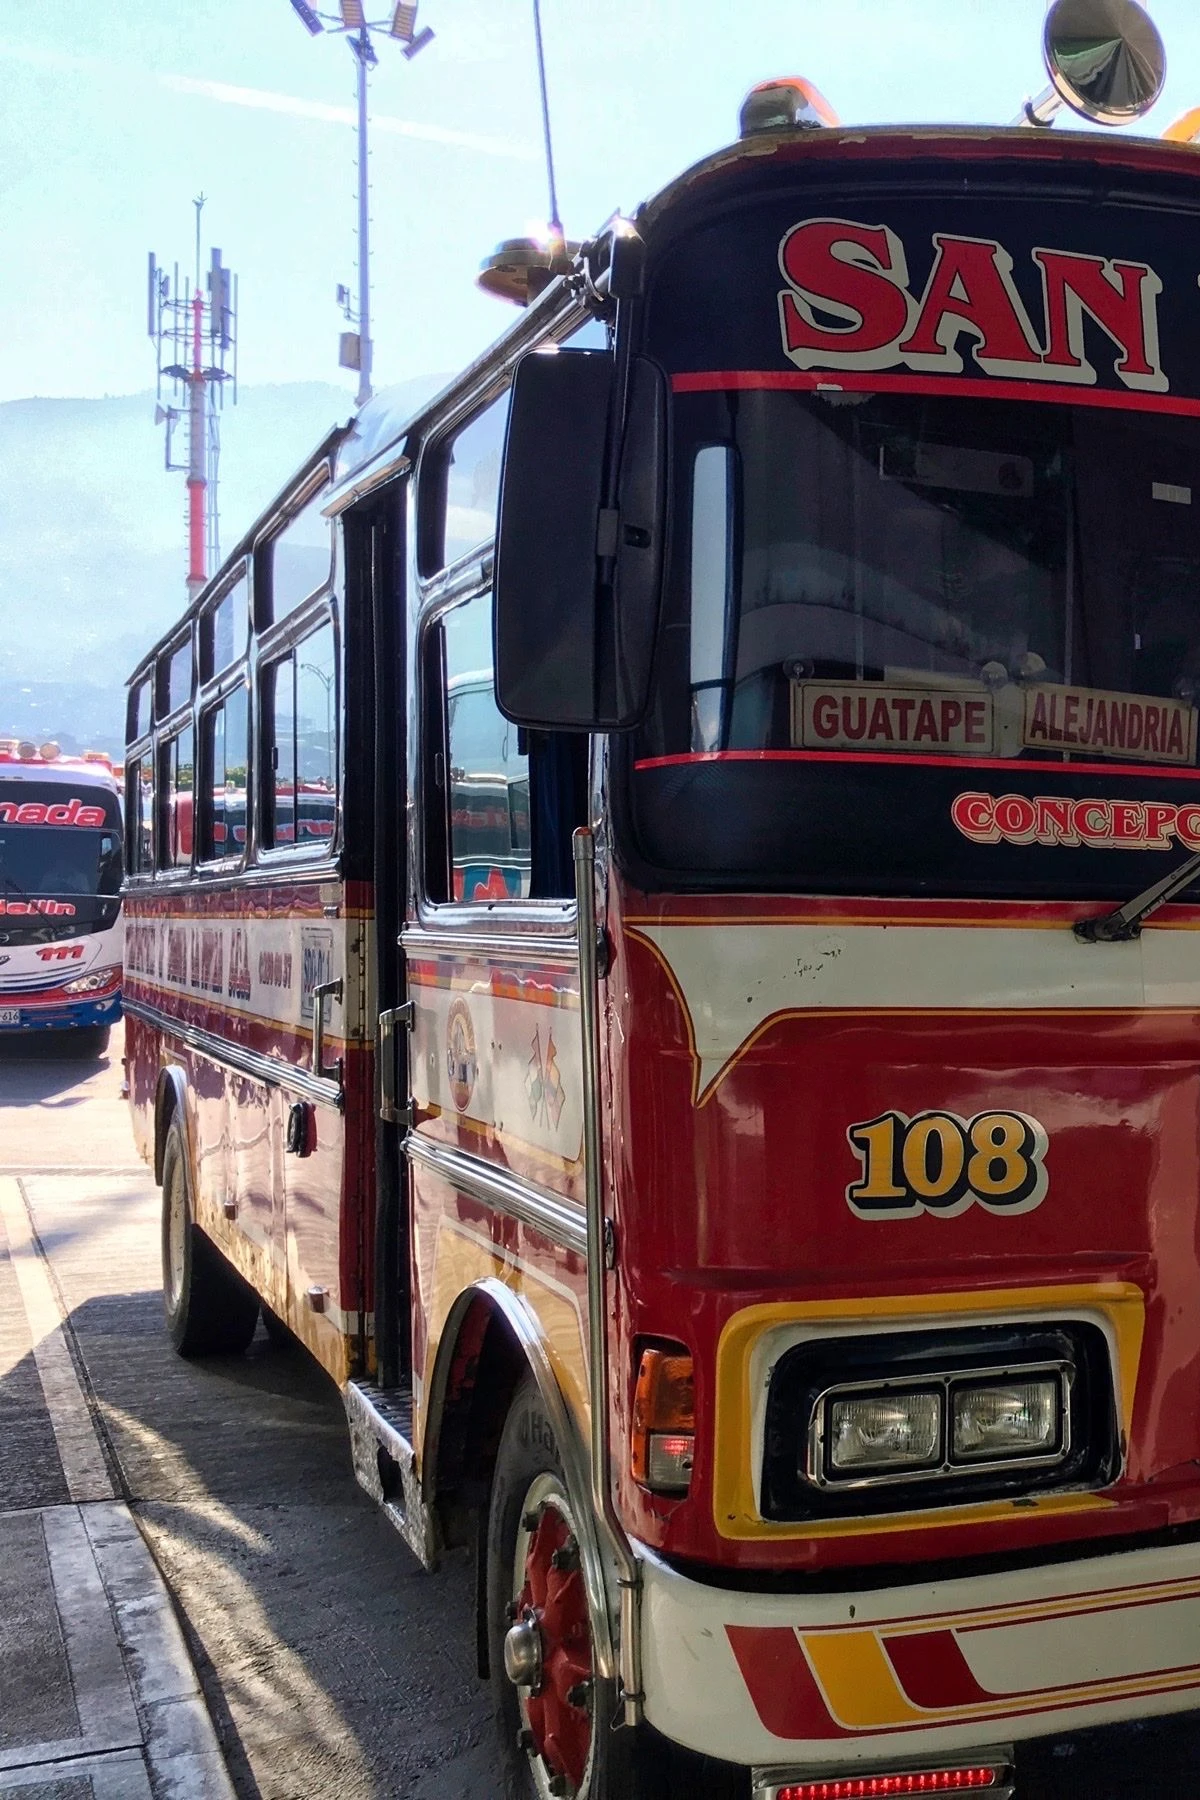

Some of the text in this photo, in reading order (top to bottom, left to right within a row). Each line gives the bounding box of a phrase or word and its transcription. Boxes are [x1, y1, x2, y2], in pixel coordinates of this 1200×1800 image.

[778, 218, 1169, 392] SAN
[812, 695, 987, 743] GUATAPE
[1029, 692, 1184, 754] ALEJANDRIA
[845, 1110, 1049, 1221] 108
